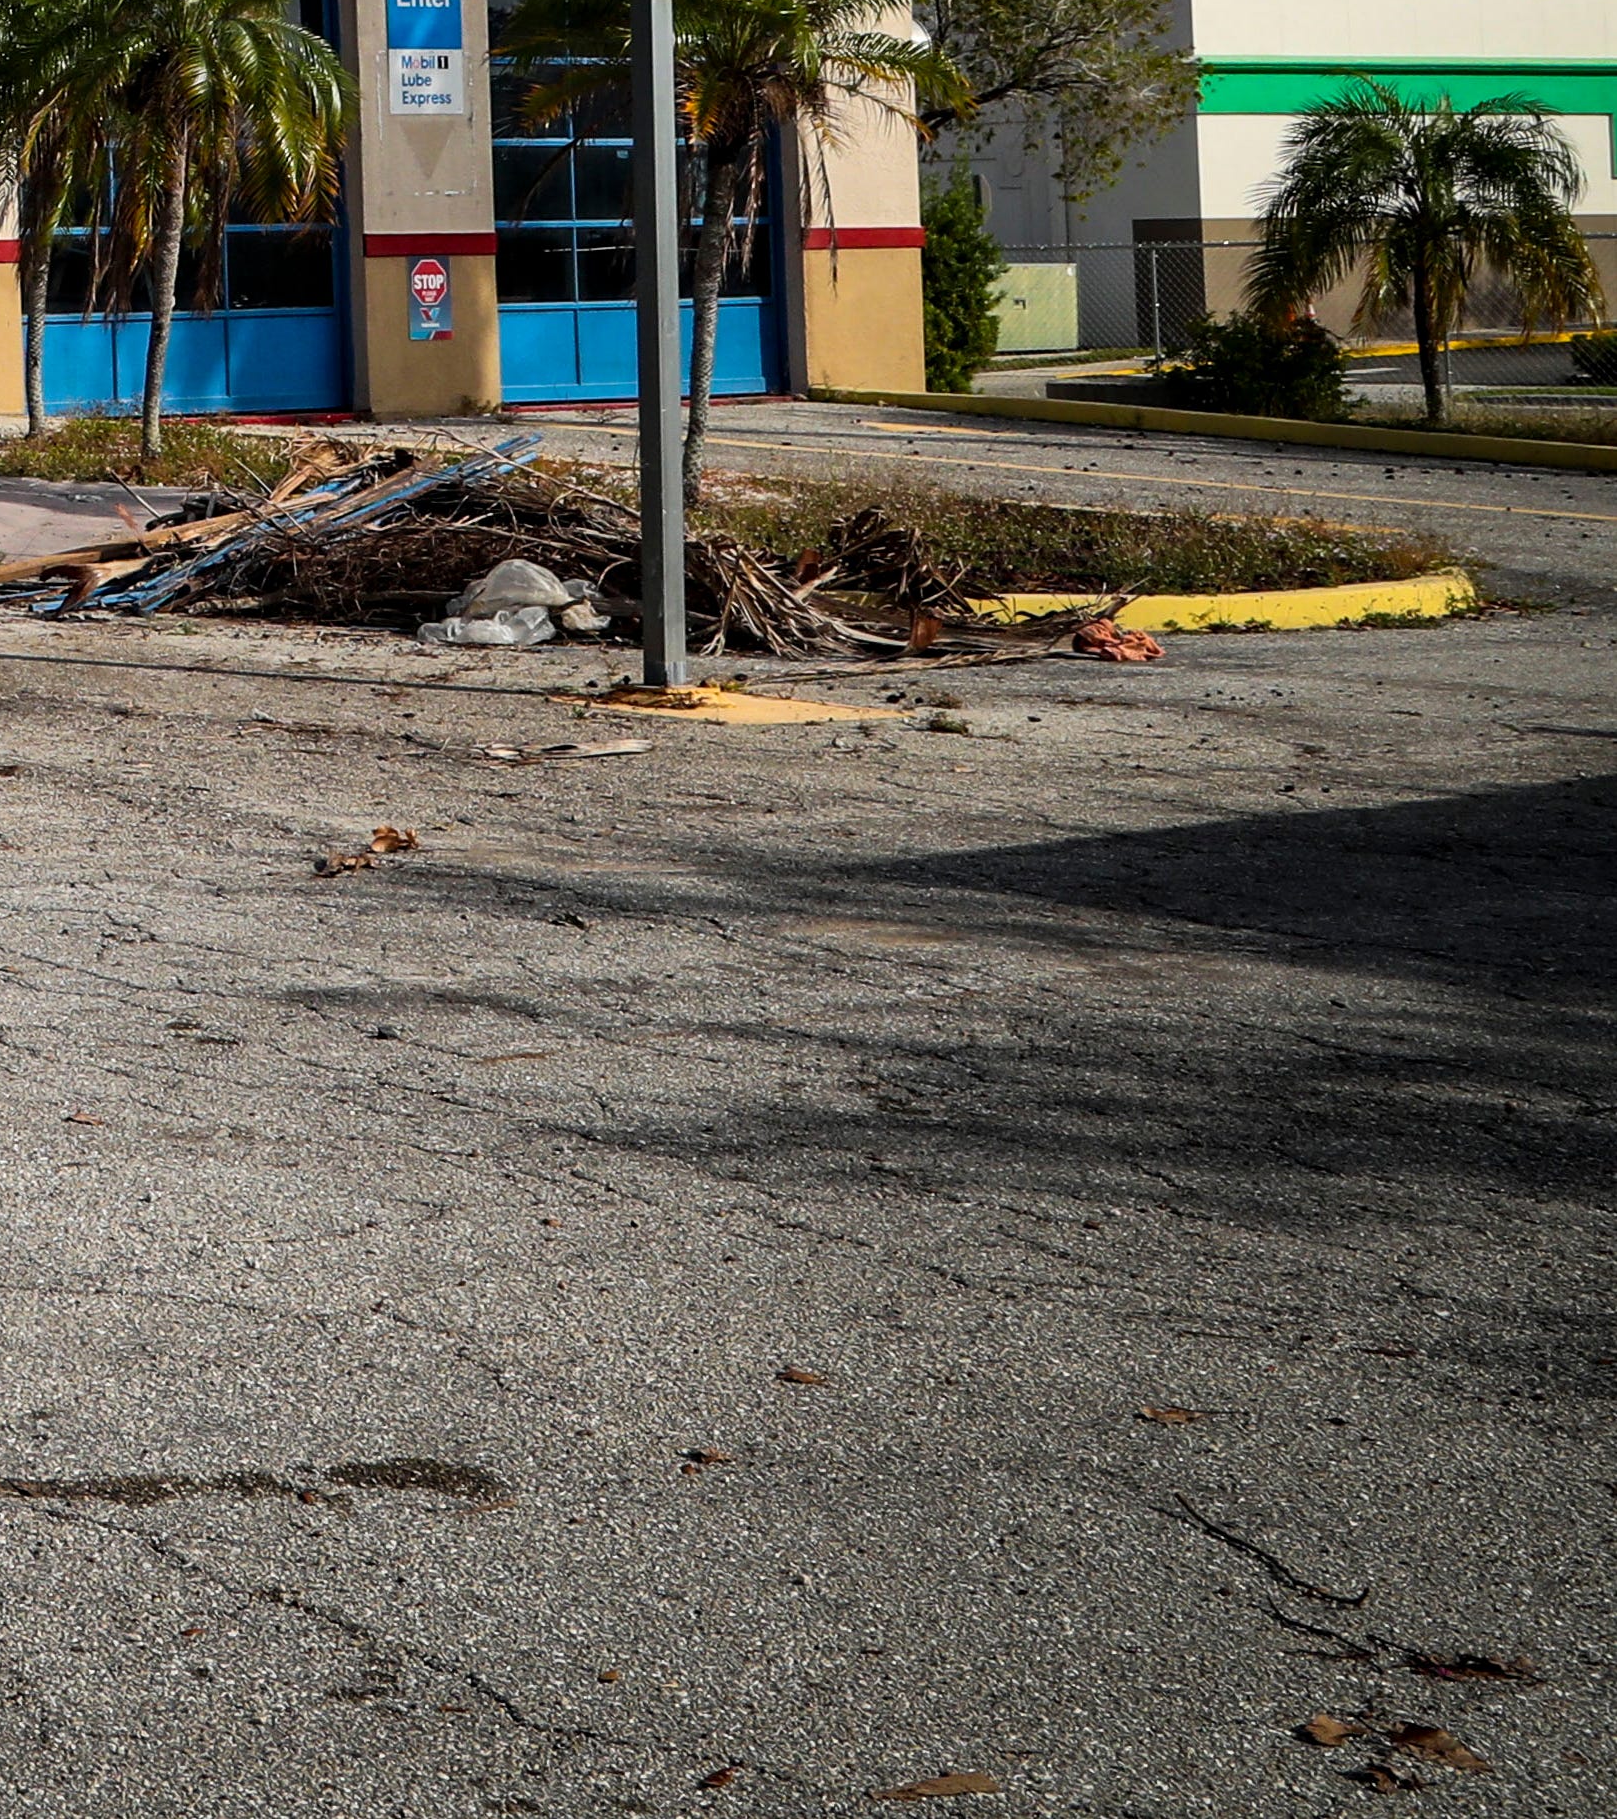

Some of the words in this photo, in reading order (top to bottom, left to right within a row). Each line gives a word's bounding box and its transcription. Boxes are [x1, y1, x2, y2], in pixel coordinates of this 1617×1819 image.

[401, 55, 435, 69] Mobil
[401, 73, 432, 87] Lube
[402, 91, 452, 108] Express
[414, 274, 444, 290] STOP
